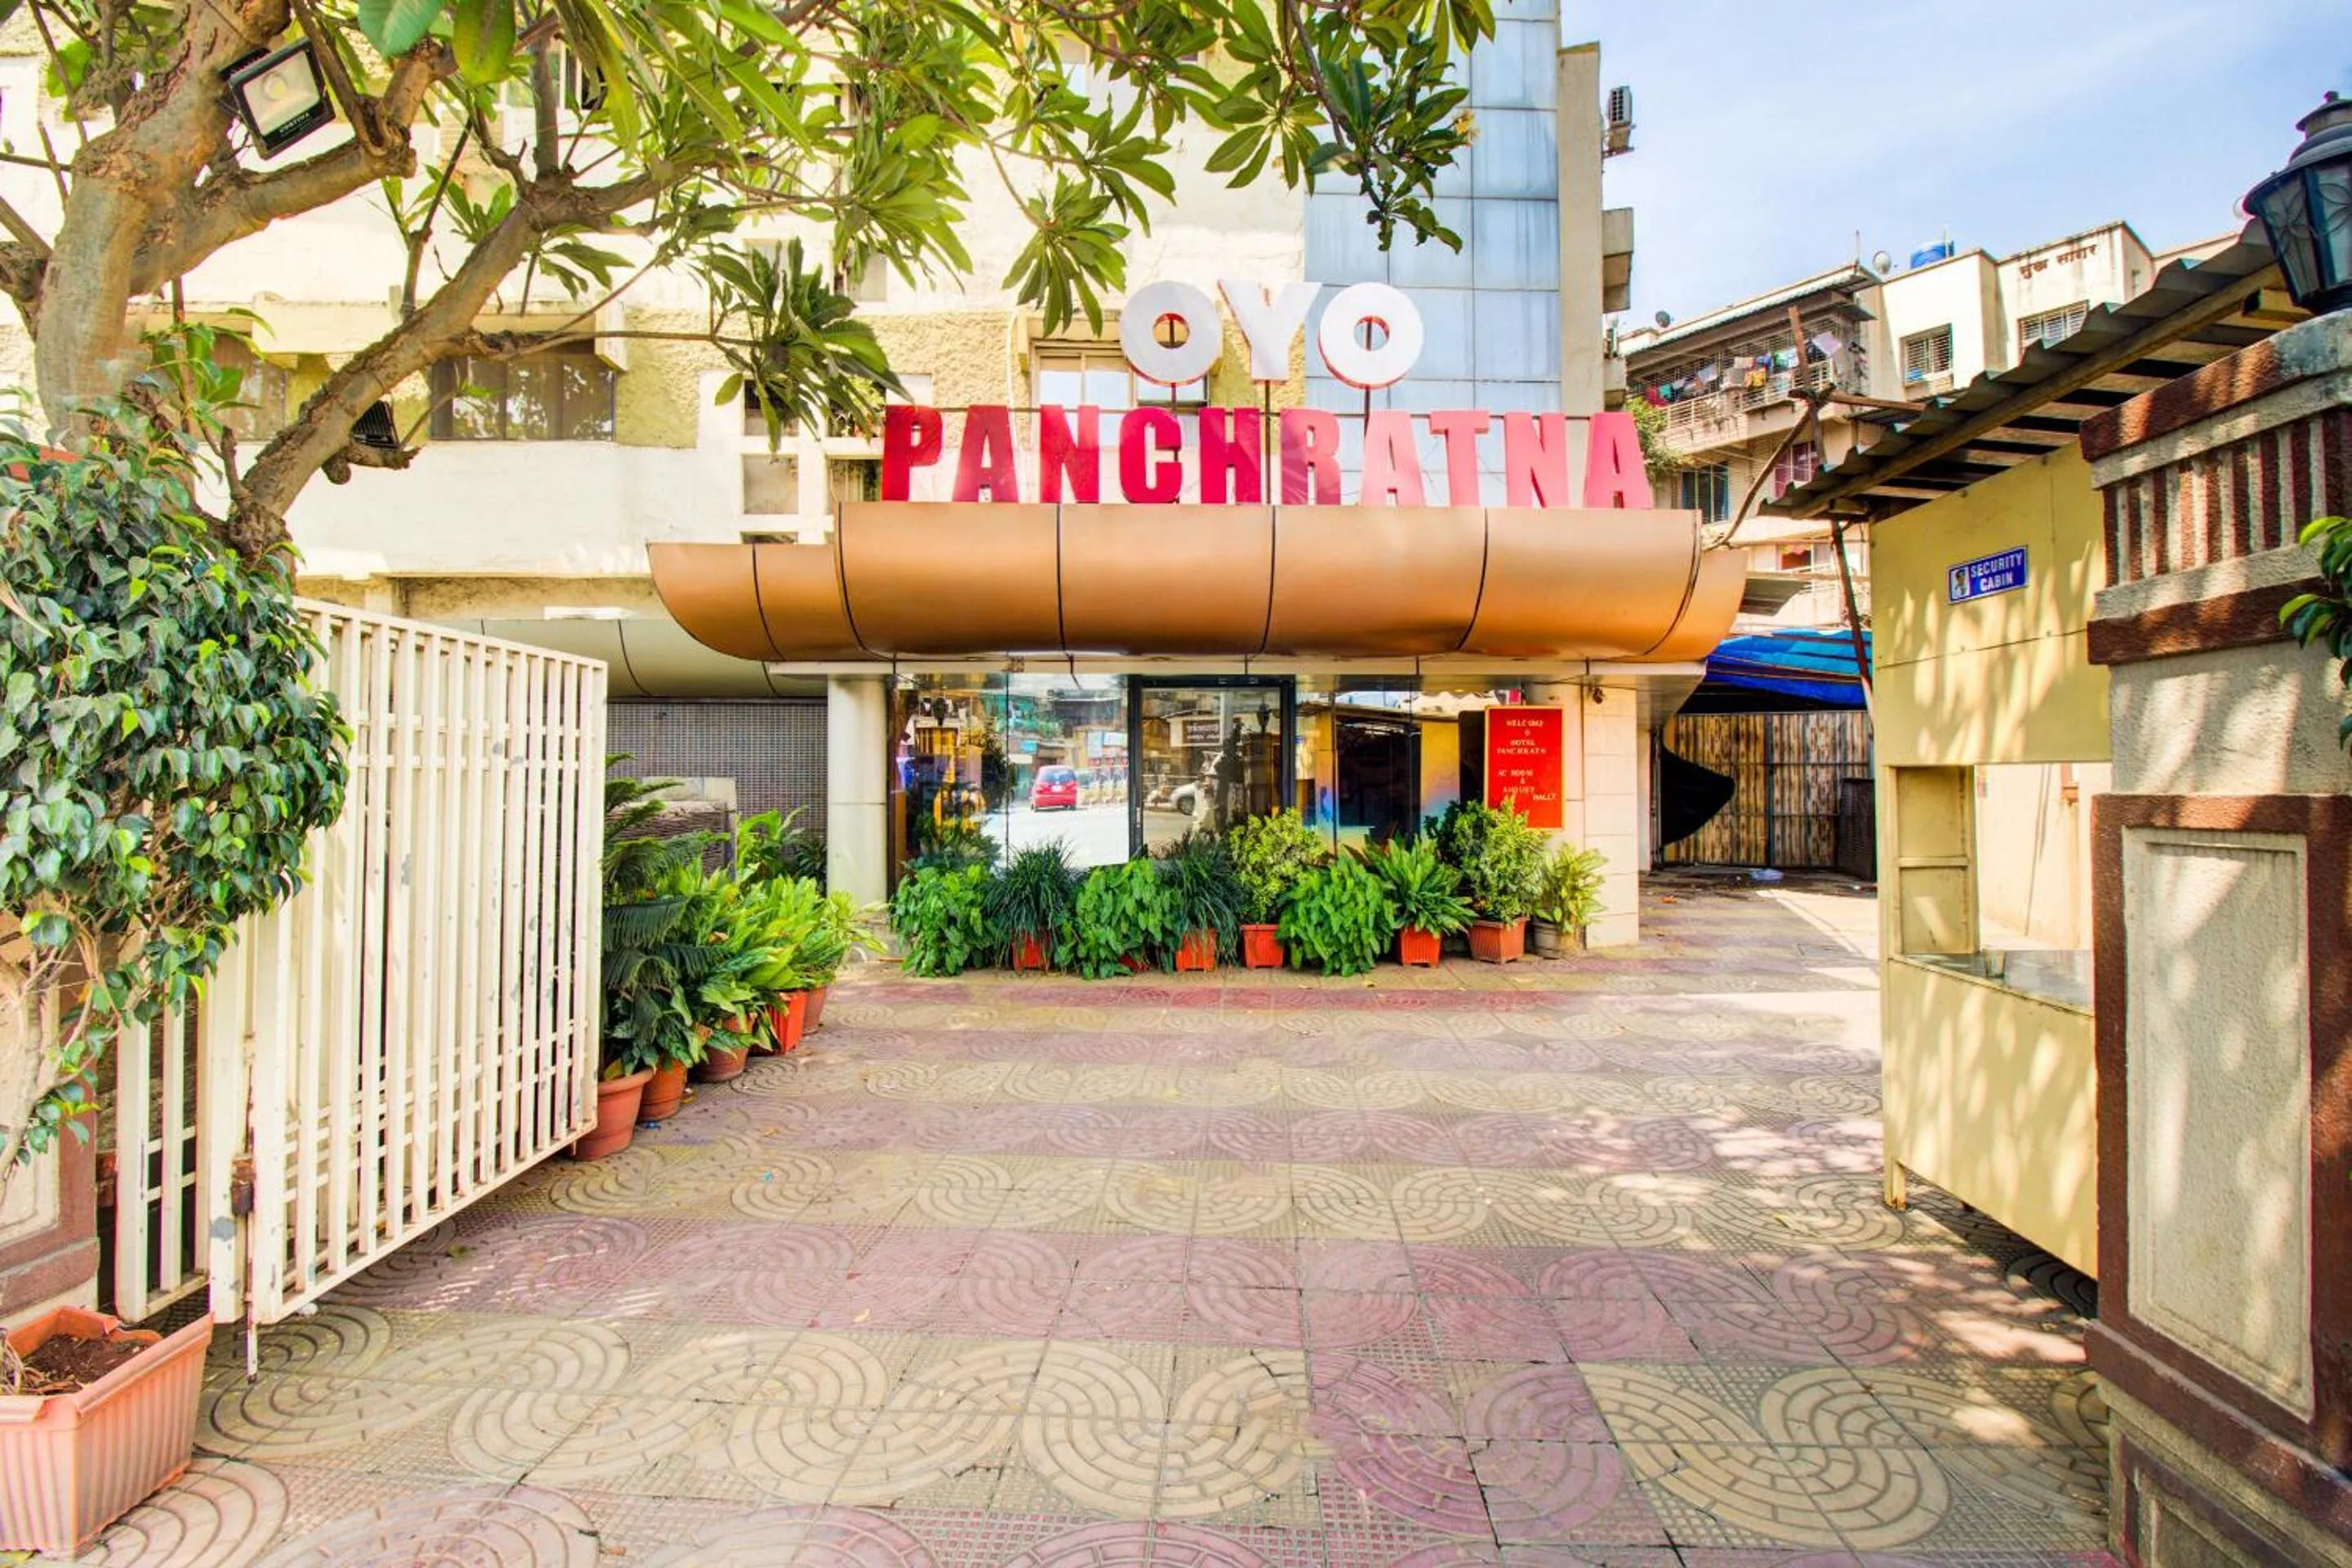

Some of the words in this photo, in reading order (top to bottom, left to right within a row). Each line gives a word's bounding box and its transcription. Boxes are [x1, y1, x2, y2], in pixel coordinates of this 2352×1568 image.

[1120, 279, 1423, 390] OYO
[881, 404, 1653, 509] PANCHRATNA
[1971, 552, 2022, 578] SECURITY
[1980, 572, 2014, 591] CABIN
